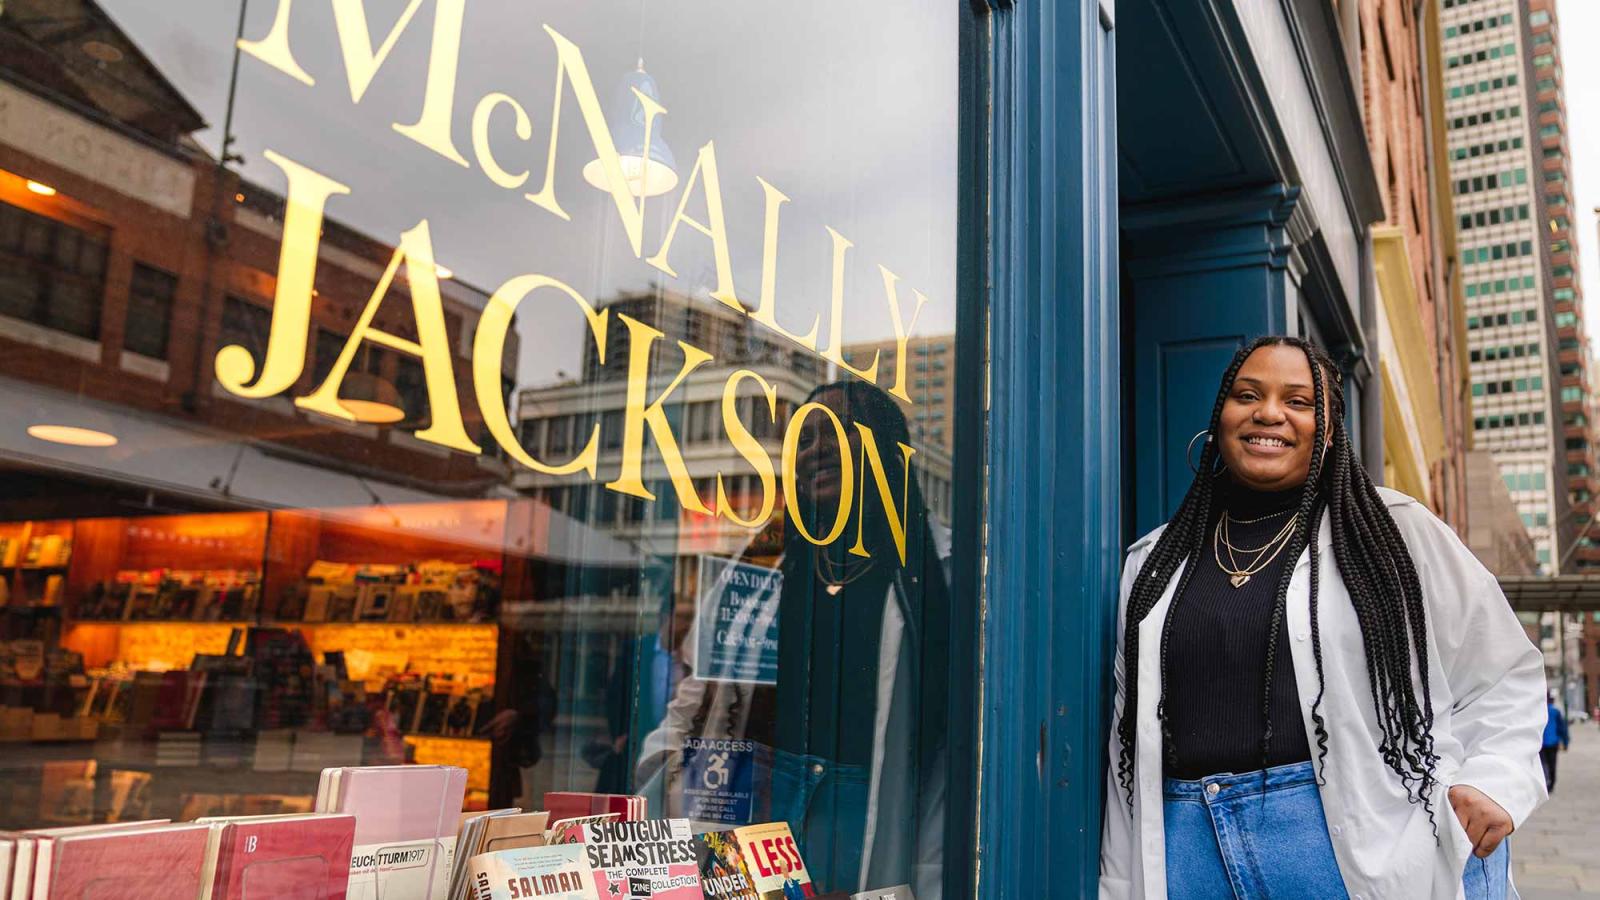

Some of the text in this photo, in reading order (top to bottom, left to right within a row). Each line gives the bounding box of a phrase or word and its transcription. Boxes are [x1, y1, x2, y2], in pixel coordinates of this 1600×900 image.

[238, 0, 928, 403] McNALLY
[215, 150, 915, 567] JACKSON
[686, 738, 753, 752] ADA ACCESS
[590, 819, 673, 843] SHOTGUN
[351, 849, 425, 868] EUCHTTURM1917
[586, 839, 698, 869] SEAMSTRESS
[749, 835, 802, 878] LESS
[508, 870, 583, 899] SALMAN
[608, 866, 668, 880] THE COMPLETE
[632, 876, 697, 893] ZINE COLLECTION
[703, 873, 749, 897] UNDER
